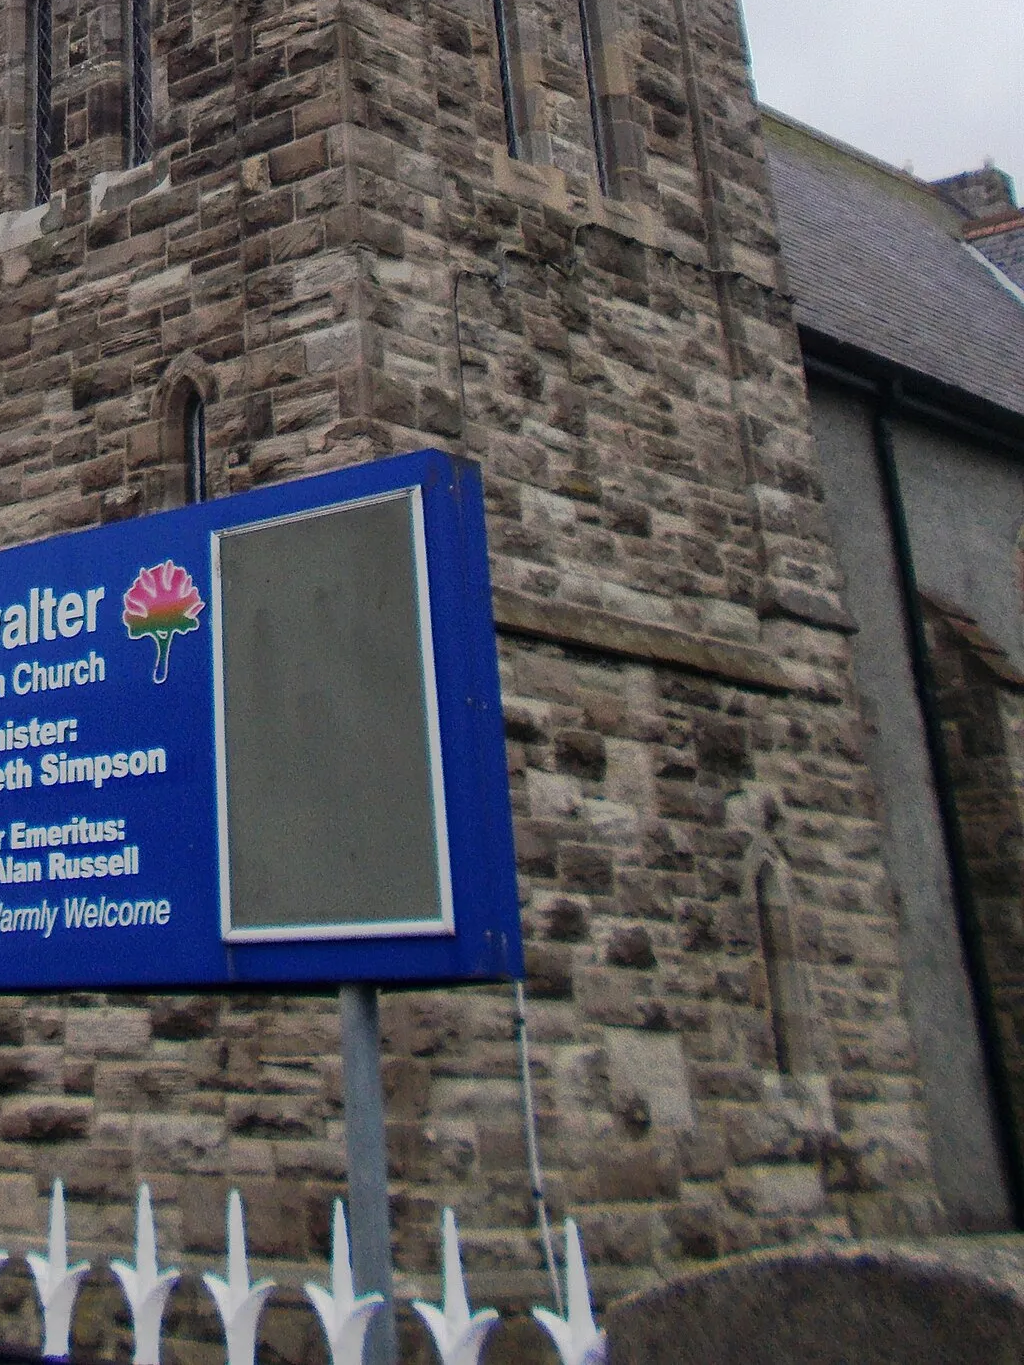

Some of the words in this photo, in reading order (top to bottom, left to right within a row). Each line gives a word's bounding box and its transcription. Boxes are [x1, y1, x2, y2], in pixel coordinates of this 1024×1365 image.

[12, 651, 106, 696] Church
[40, 748, 166, 789] Simpson
[10, 816, 125, 850] Emeritus:
[48, 846, 139, 881] Russell
[64, 896, 172, 929] Welcome
